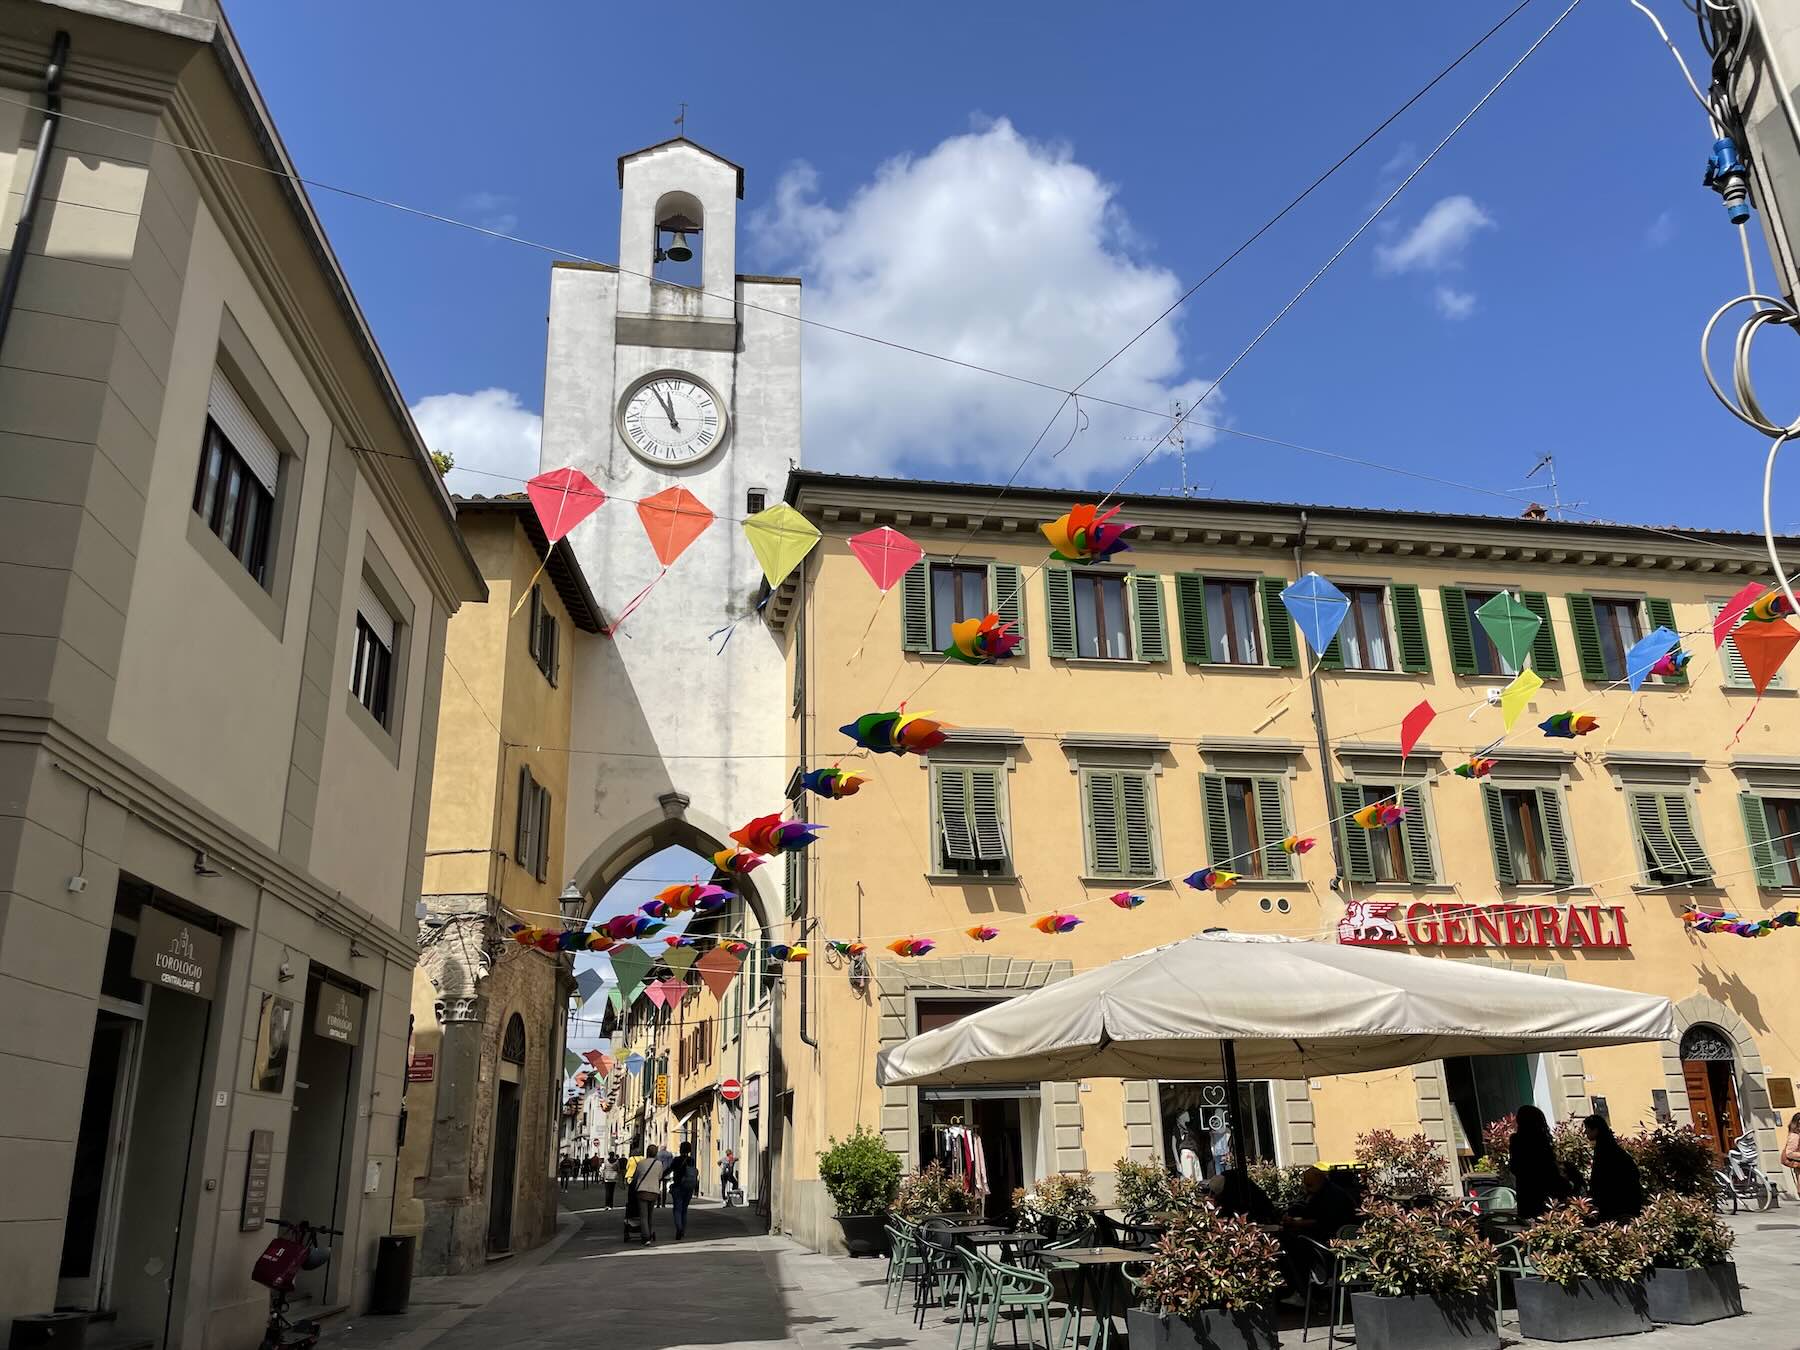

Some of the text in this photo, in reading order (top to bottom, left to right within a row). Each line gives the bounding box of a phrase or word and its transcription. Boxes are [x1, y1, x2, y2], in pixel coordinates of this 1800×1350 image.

[665, 380, 681, 391] XII
[699, 399, 712, 408] II
[704, 416, 717, 426] III
[665, 447, 677, 459] VI
[1405, 902, 1632, 948] GENERALI
[155, 952, 203, 979] L'OROLOGIO
